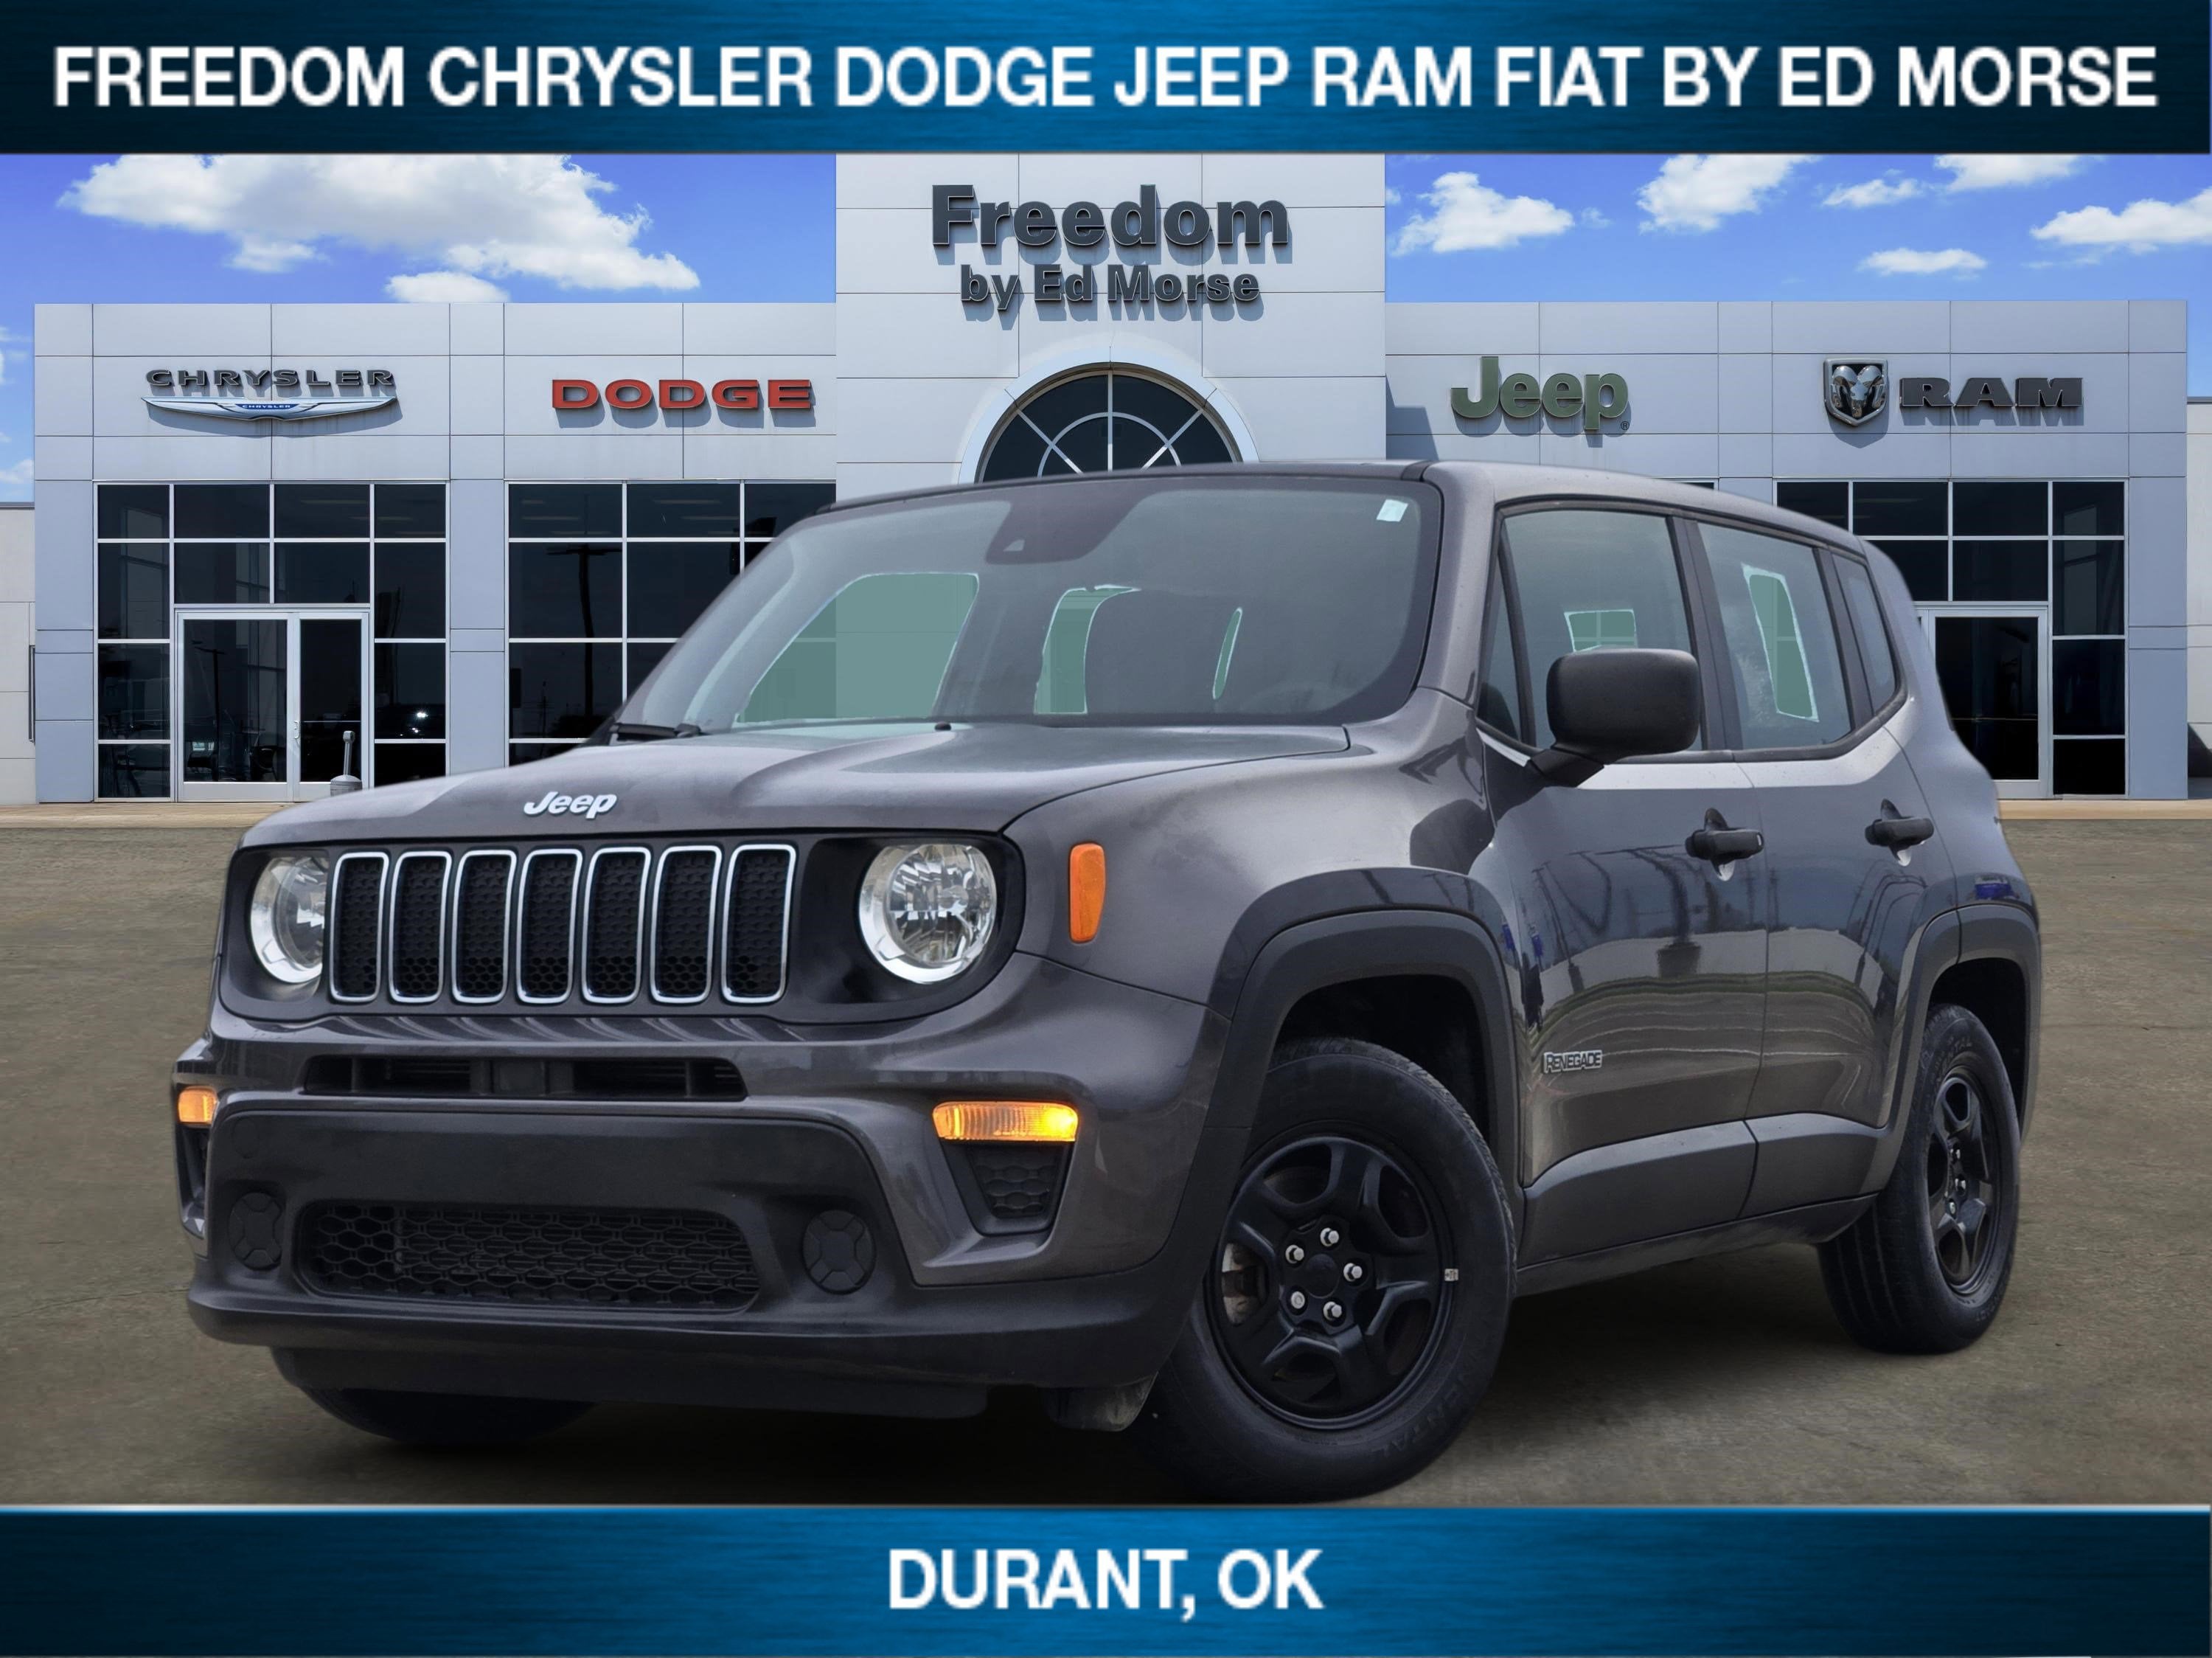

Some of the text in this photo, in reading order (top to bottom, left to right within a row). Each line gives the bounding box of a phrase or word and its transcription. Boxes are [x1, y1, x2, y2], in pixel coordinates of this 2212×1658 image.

[932, 184, 1290, 246] Freedom
[961, 264, 1260, 311] by Ed Morse
[145, 369, 394, 387] CHRYSLER
[1450, 355, 1629, 431] Jeep
[1899, 377, 2084, 408] RAM
[552, 379, 813, 409] DODGE
[524, 791, 618, 819] Jeep
[1544, 1050, 1603, 1073] RENEGADE
